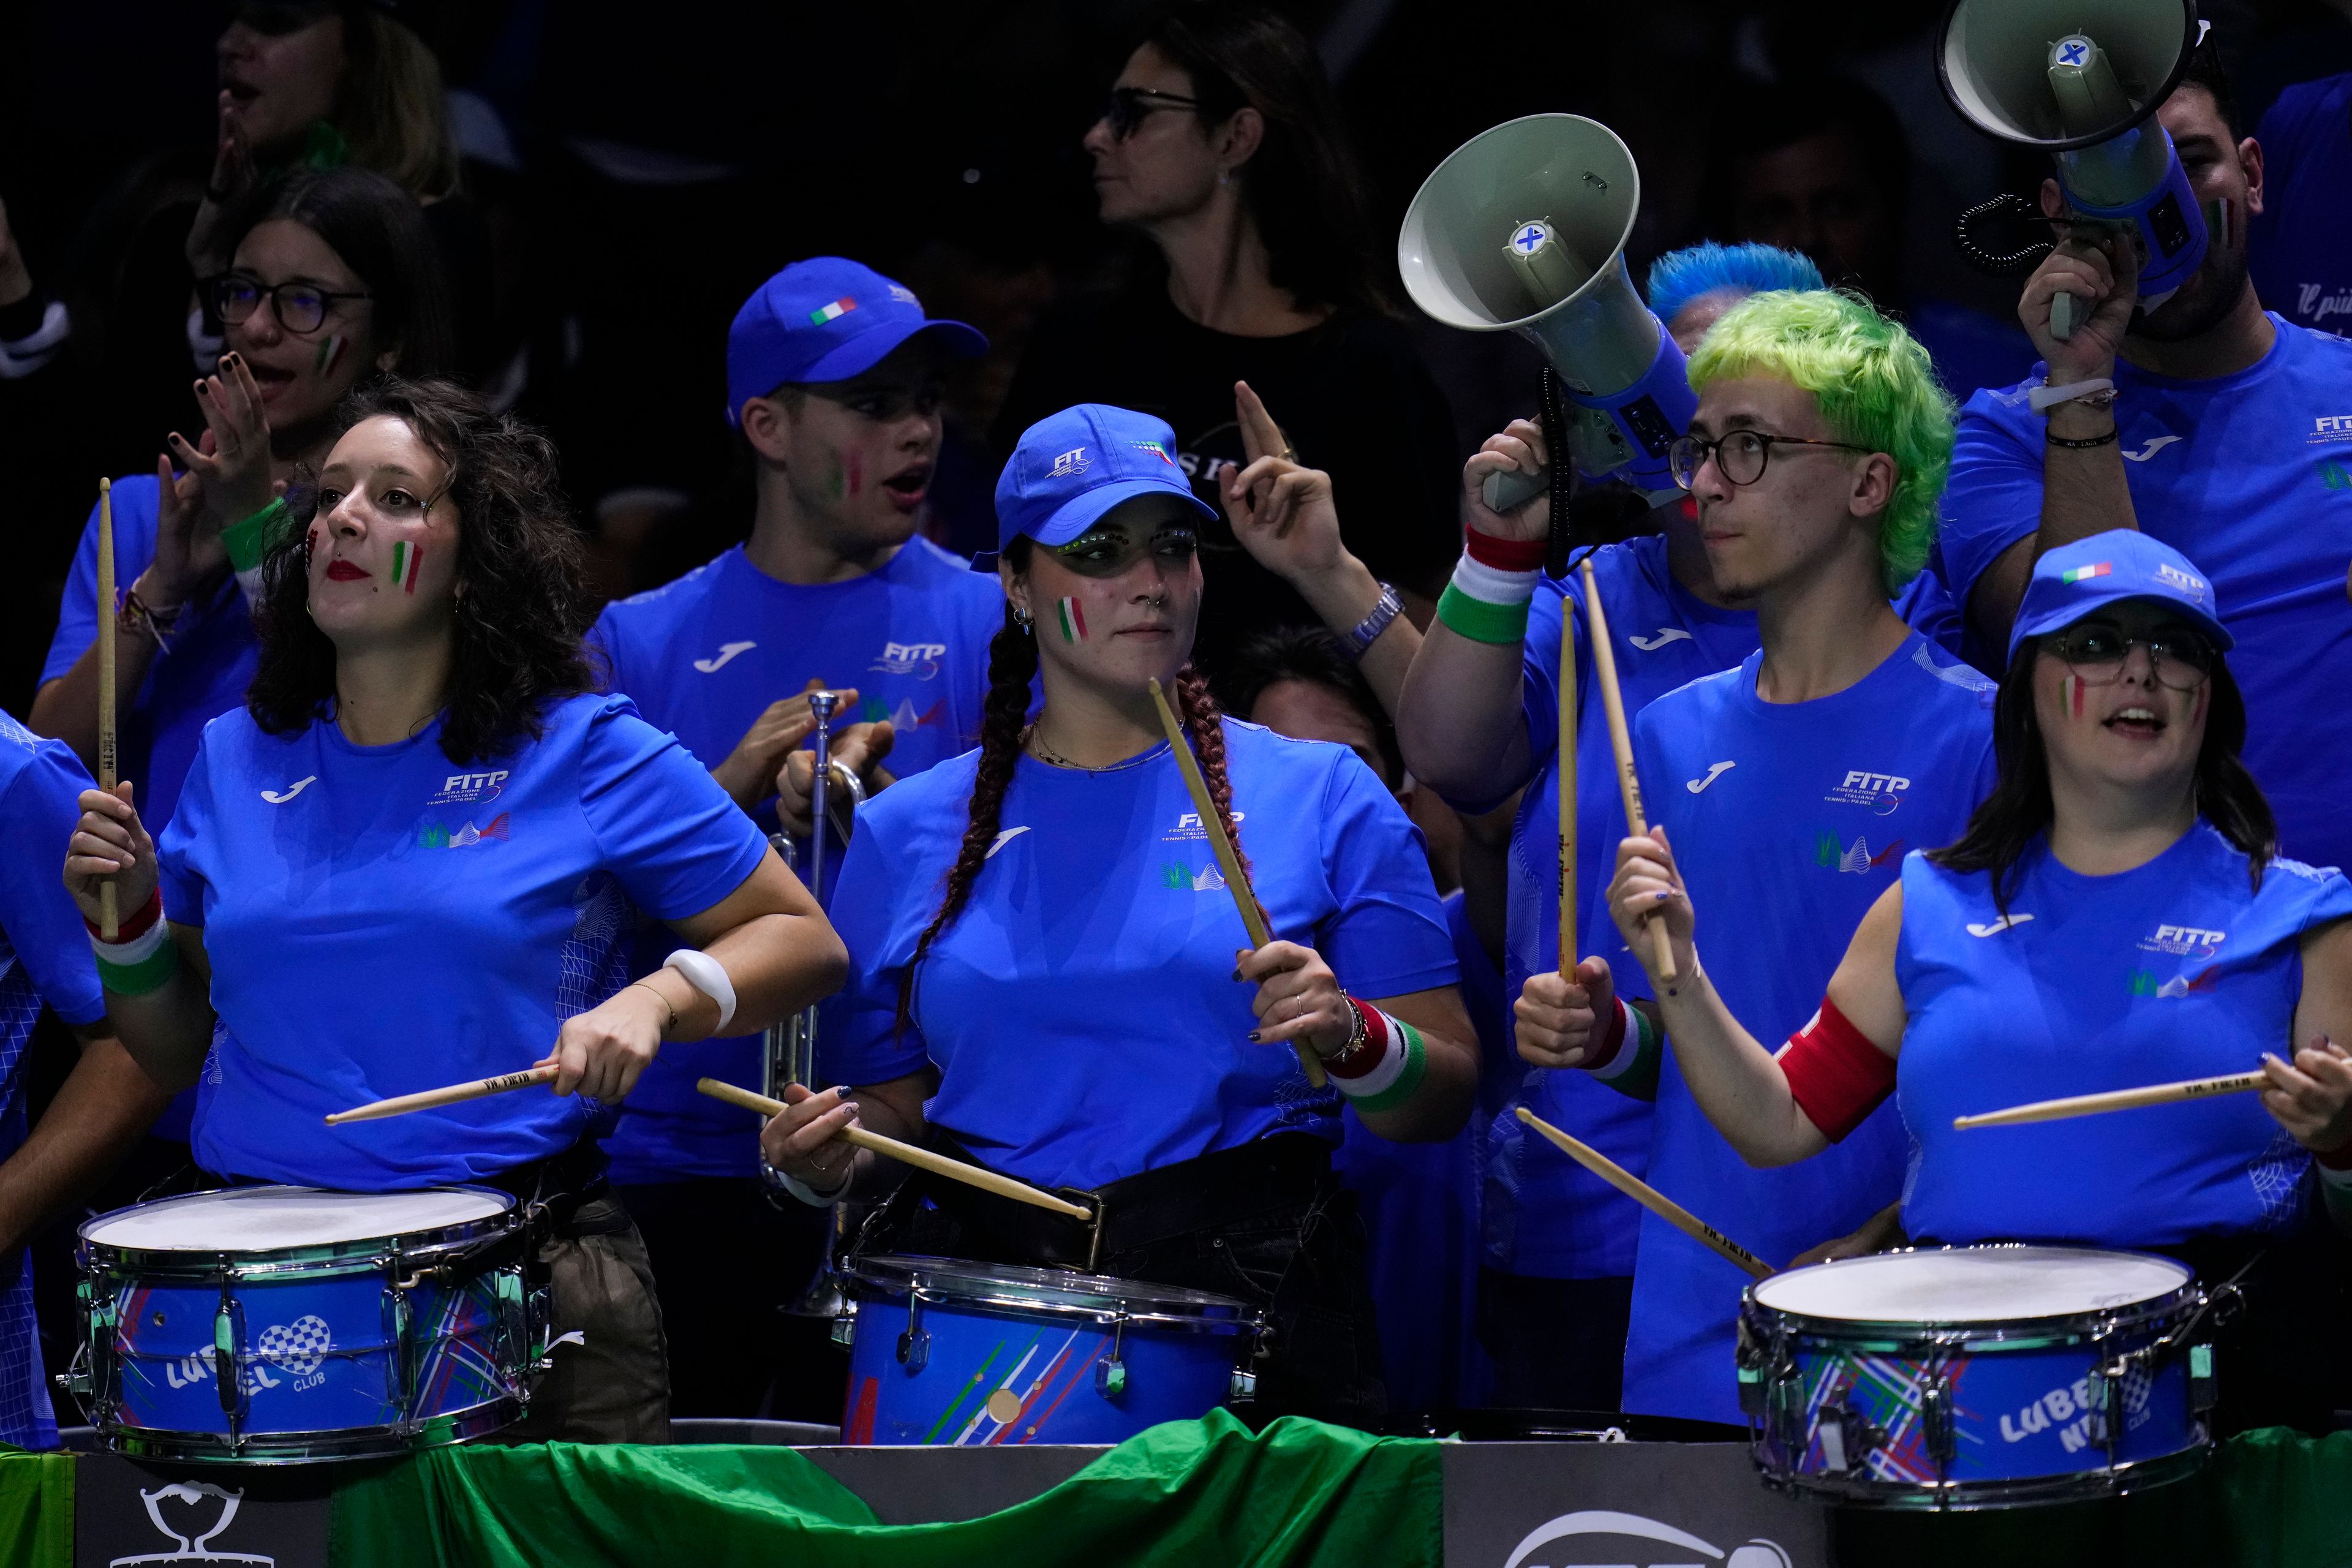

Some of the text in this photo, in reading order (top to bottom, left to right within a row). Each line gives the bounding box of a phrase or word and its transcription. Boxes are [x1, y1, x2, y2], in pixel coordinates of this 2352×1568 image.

[1054, 447, 1086, 470] FIT
[443, 770, 509, 791] FITP
[1842, 771, 1910, 793] FITP
[434, 788, 480, 797] FEDERAZIONE
[1832, 787, 1877, 796] FEDERAZIONE
[1178, 812, 1245, 828] FIP
[2155, 924, 2226, 946] FITP
[502, 1072, 530, 1087] FIRTH
[293, 1372, 326, 1392] CLUB
